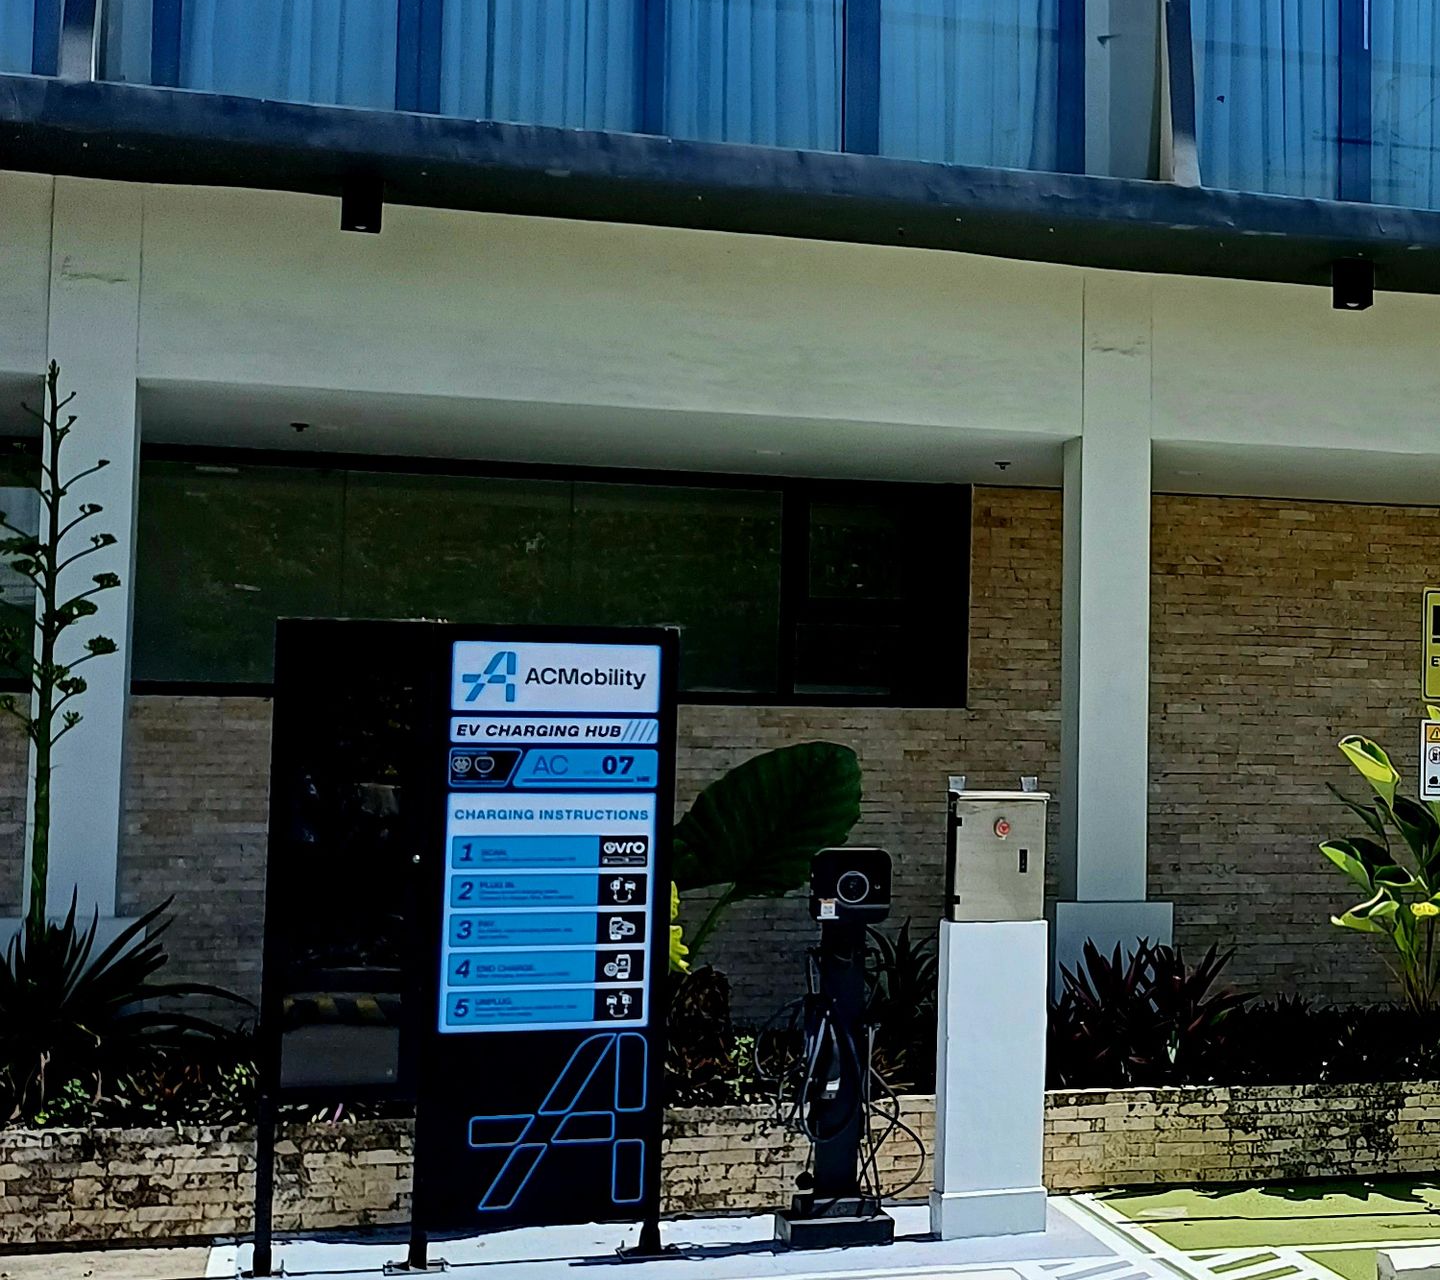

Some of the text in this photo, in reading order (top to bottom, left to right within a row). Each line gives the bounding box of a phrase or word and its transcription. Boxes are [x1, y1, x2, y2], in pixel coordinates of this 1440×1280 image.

[525, 667, 646, 690] ACMobility
[457, 724, 621, 737] EV CHARGING HUB
[532, 755, 634, 776] AC 07
[454, 809, 649, 821] CHARGING INSTRUCTIONS
[460, 842, 472, 861] 1
[458, 881, 474, 900] 2
[457, 920, 472, 940] 3
[455, 960, 470, 978] 4
[453, 998, 470, 1017] 5
